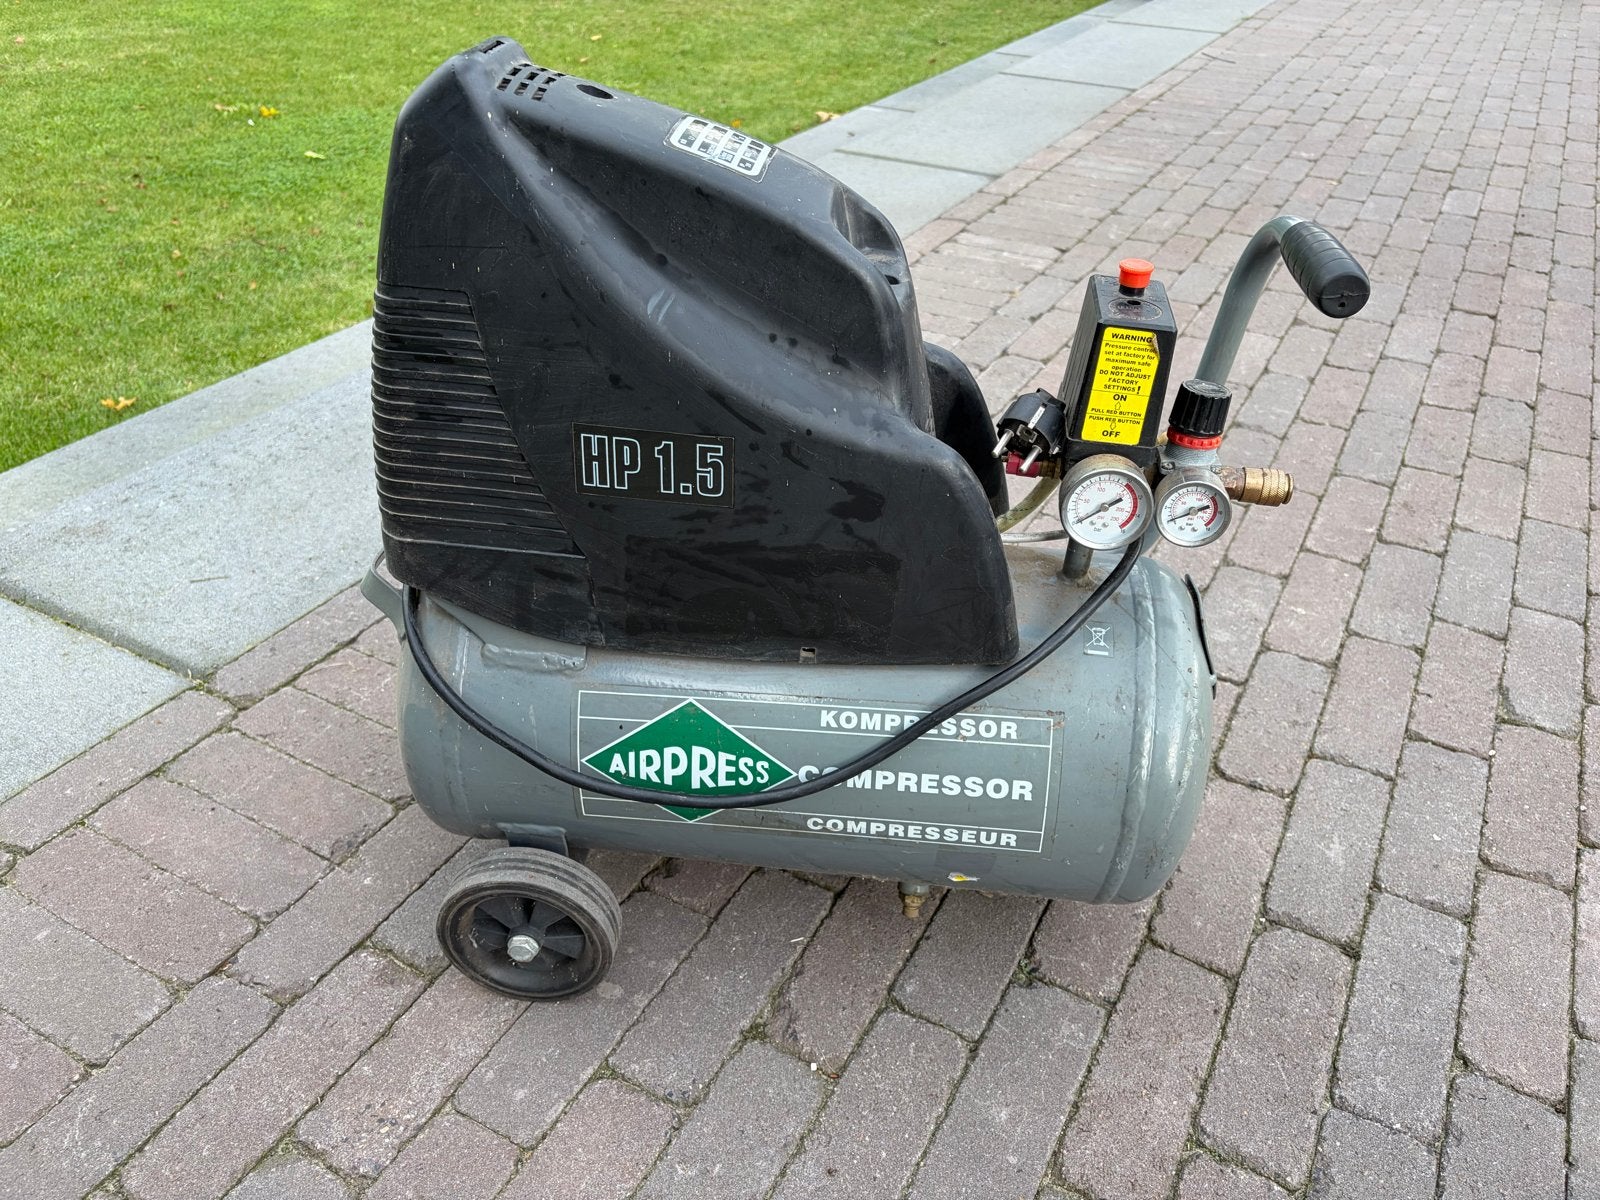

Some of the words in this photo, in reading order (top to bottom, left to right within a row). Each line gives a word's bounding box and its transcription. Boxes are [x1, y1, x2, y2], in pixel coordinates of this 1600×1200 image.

[1111, 332, 1153, 344] WARNING
[1105, 342, 1132, 351] Pressure
[1123, 351, 1146, 360] factory
[1105, 357, 1137, 365] maximum
[1111, 365, 1142, 373] operation
[1125, 372, 1151, 380] ADJUST
[1107, 377, 1139, 385] FACTORY
[1112, 393, 1127, 402] ON
[1118, 410, 1142, 418] BUTTON
[1101, 429, 1121, 438] OFF
[580, 433, 641, 490] HP
[654, 440, 725, 498] 1.5
[820, 709, 1018, 740] KOMPRSSOR
[609, 745, 770, 790] AIRPRESS
[798, 765, 1033, 801] CMPRESSOR
[806, 817, 1018, 847] COMPRESSEUR
